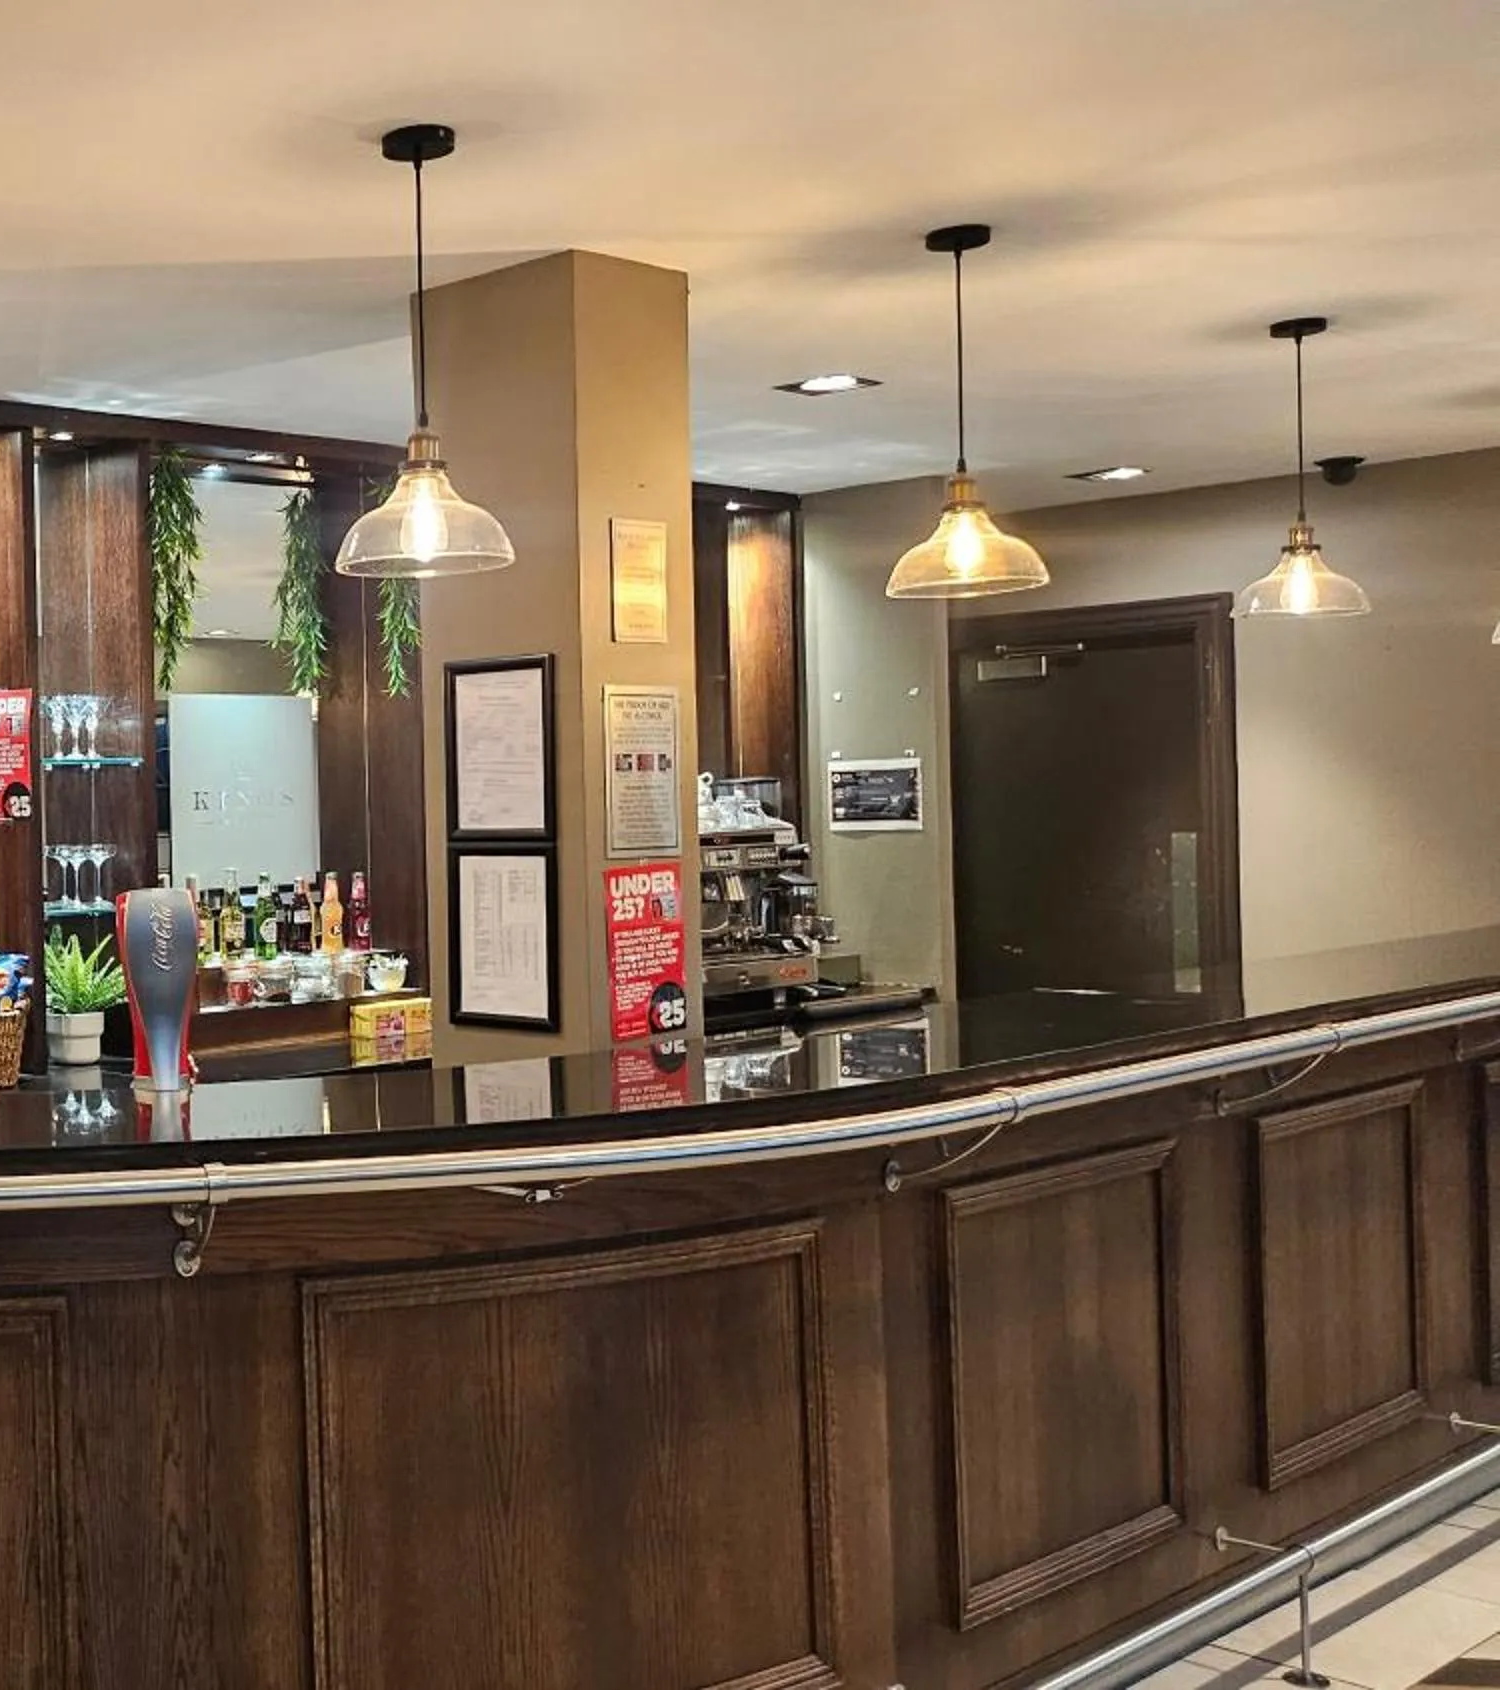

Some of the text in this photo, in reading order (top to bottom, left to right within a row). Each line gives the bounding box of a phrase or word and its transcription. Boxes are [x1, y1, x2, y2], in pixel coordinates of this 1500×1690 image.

[9, 795, 32, 818] 25
[610, 871, 675, 897] UNDER
[612, 898, 645, 922] 25?
[658, 997, 686, 1030] 25
